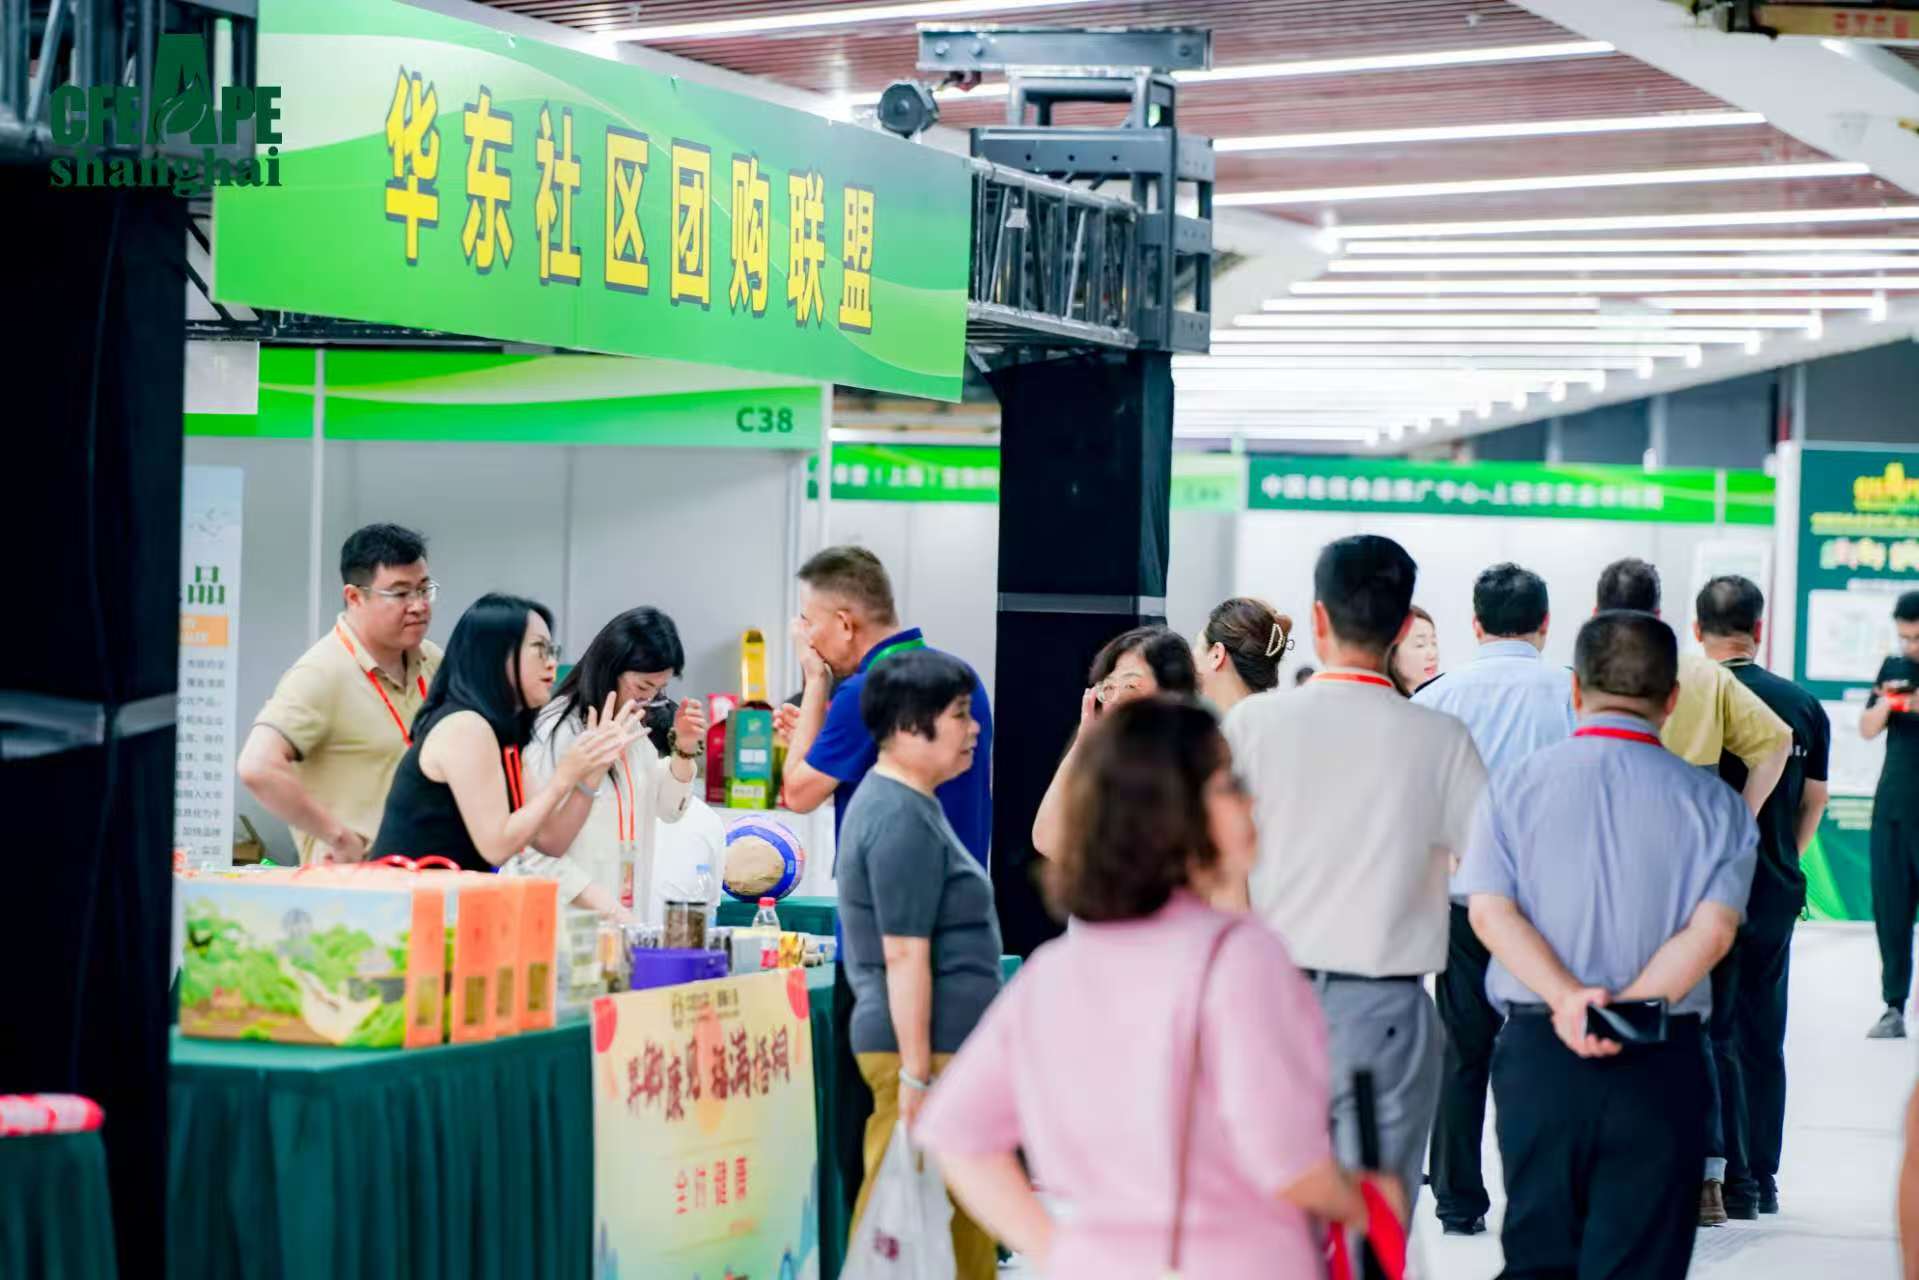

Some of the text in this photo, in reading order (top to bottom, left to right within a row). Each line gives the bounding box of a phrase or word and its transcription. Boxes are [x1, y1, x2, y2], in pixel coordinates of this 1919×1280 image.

[384, 66, 876, 335] 华东社区团购联盟
[736, 406, 794, 433] C38
